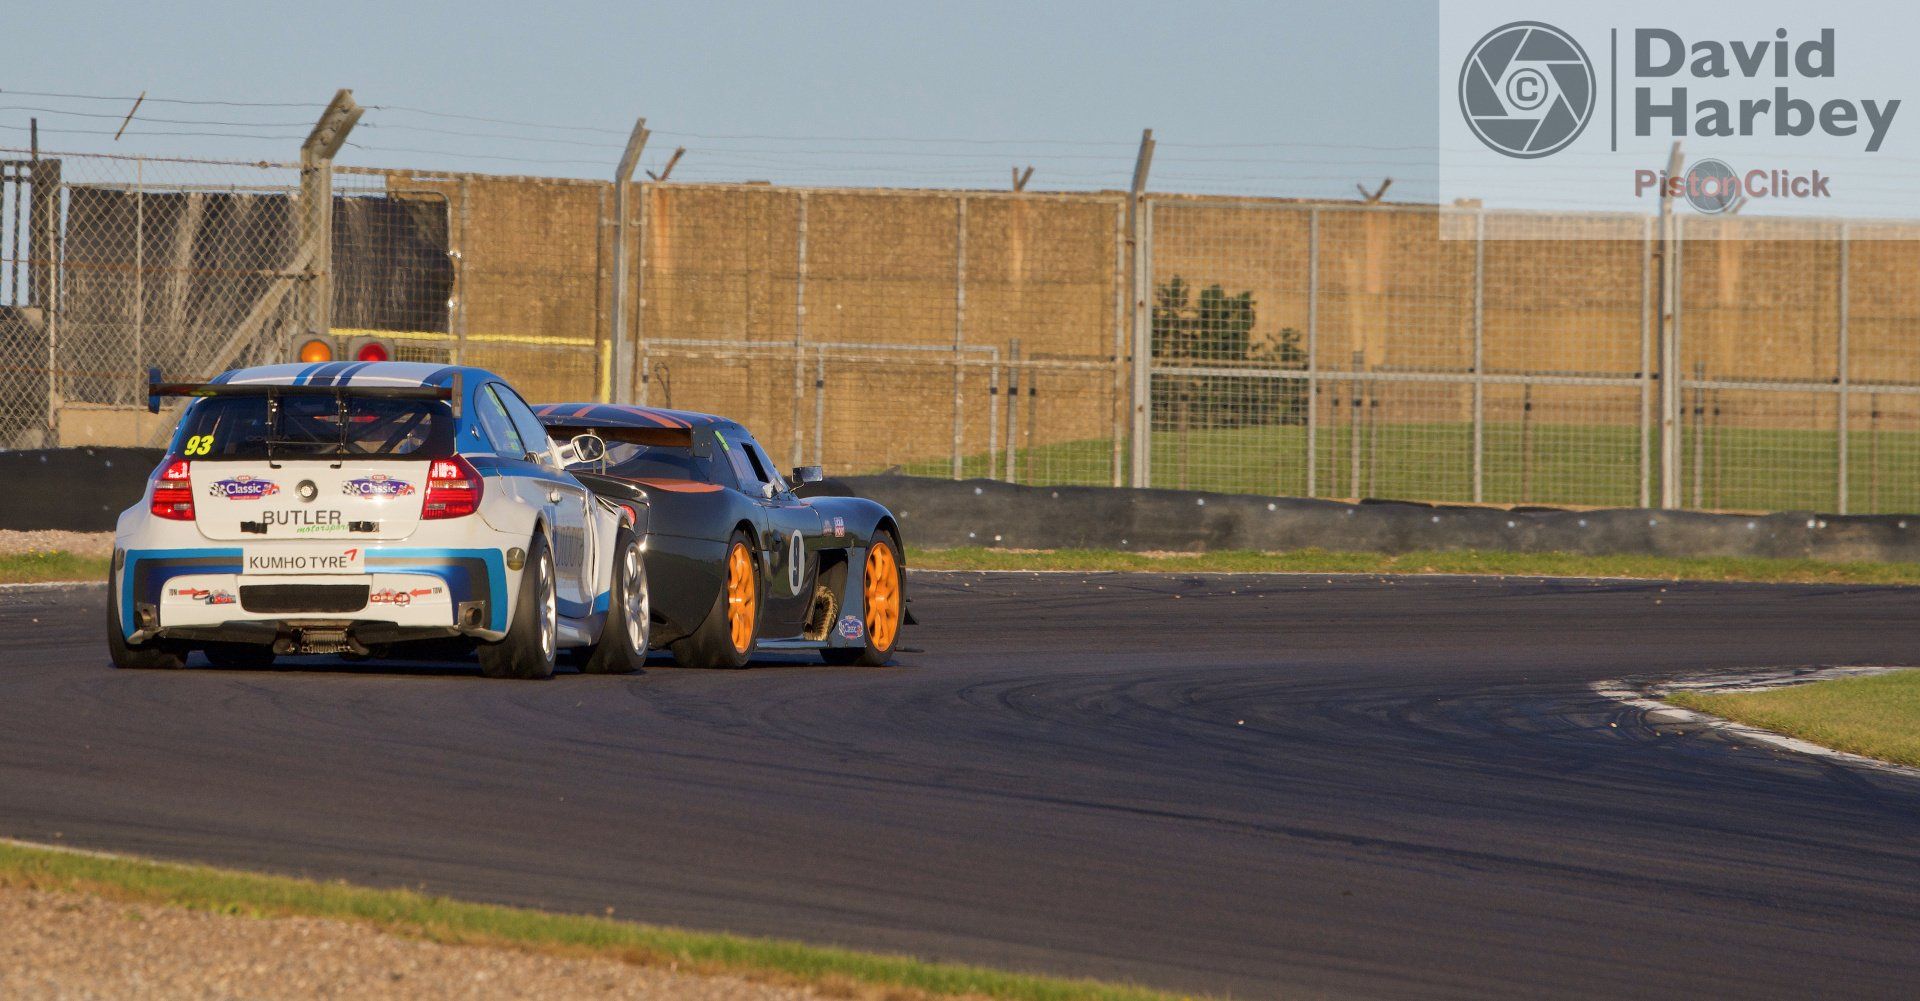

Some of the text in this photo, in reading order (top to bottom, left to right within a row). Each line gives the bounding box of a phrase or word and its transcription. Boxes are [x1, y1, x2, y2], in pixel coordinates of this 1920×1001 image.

[184, 435, 214, 456] 93
[226, 483, 262, 494] Classic
[360, 482, 397, 493] Classic
[262, 510, 342, 525] BUTLER
[249, 556, 347, 569] KUMHO TYRE
[792, 535, 800, 587] 9
